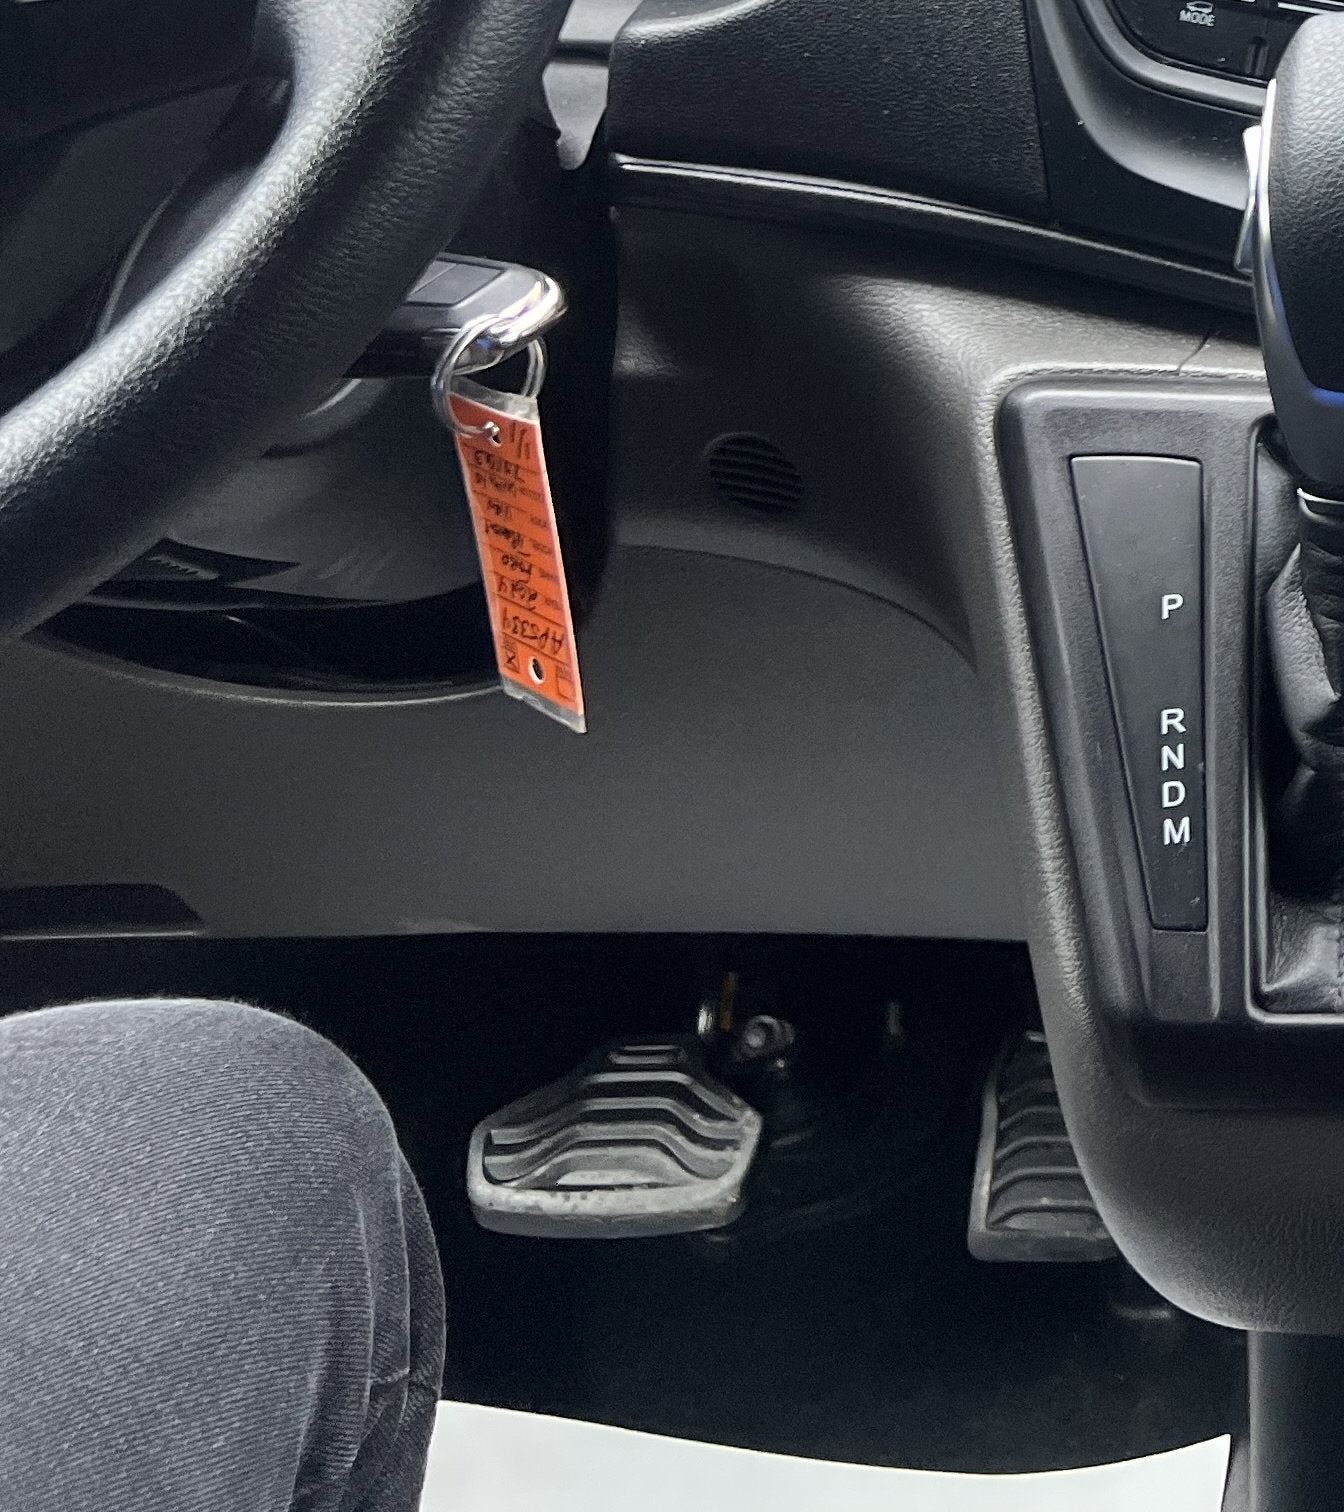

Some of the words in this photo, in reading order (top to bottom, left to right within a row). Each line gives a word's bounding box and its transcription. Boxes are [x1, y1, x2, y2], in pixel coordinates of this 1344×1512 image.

[1179, 9, 1216, 27] MODE
[1160, 593, 1184, 620] P
[1160, 707, 1186, 735] R
[1161, 743, 1185, 771] N
[1162, 780, 1186, 808] D
[1163, 817, 1191, 846] M
